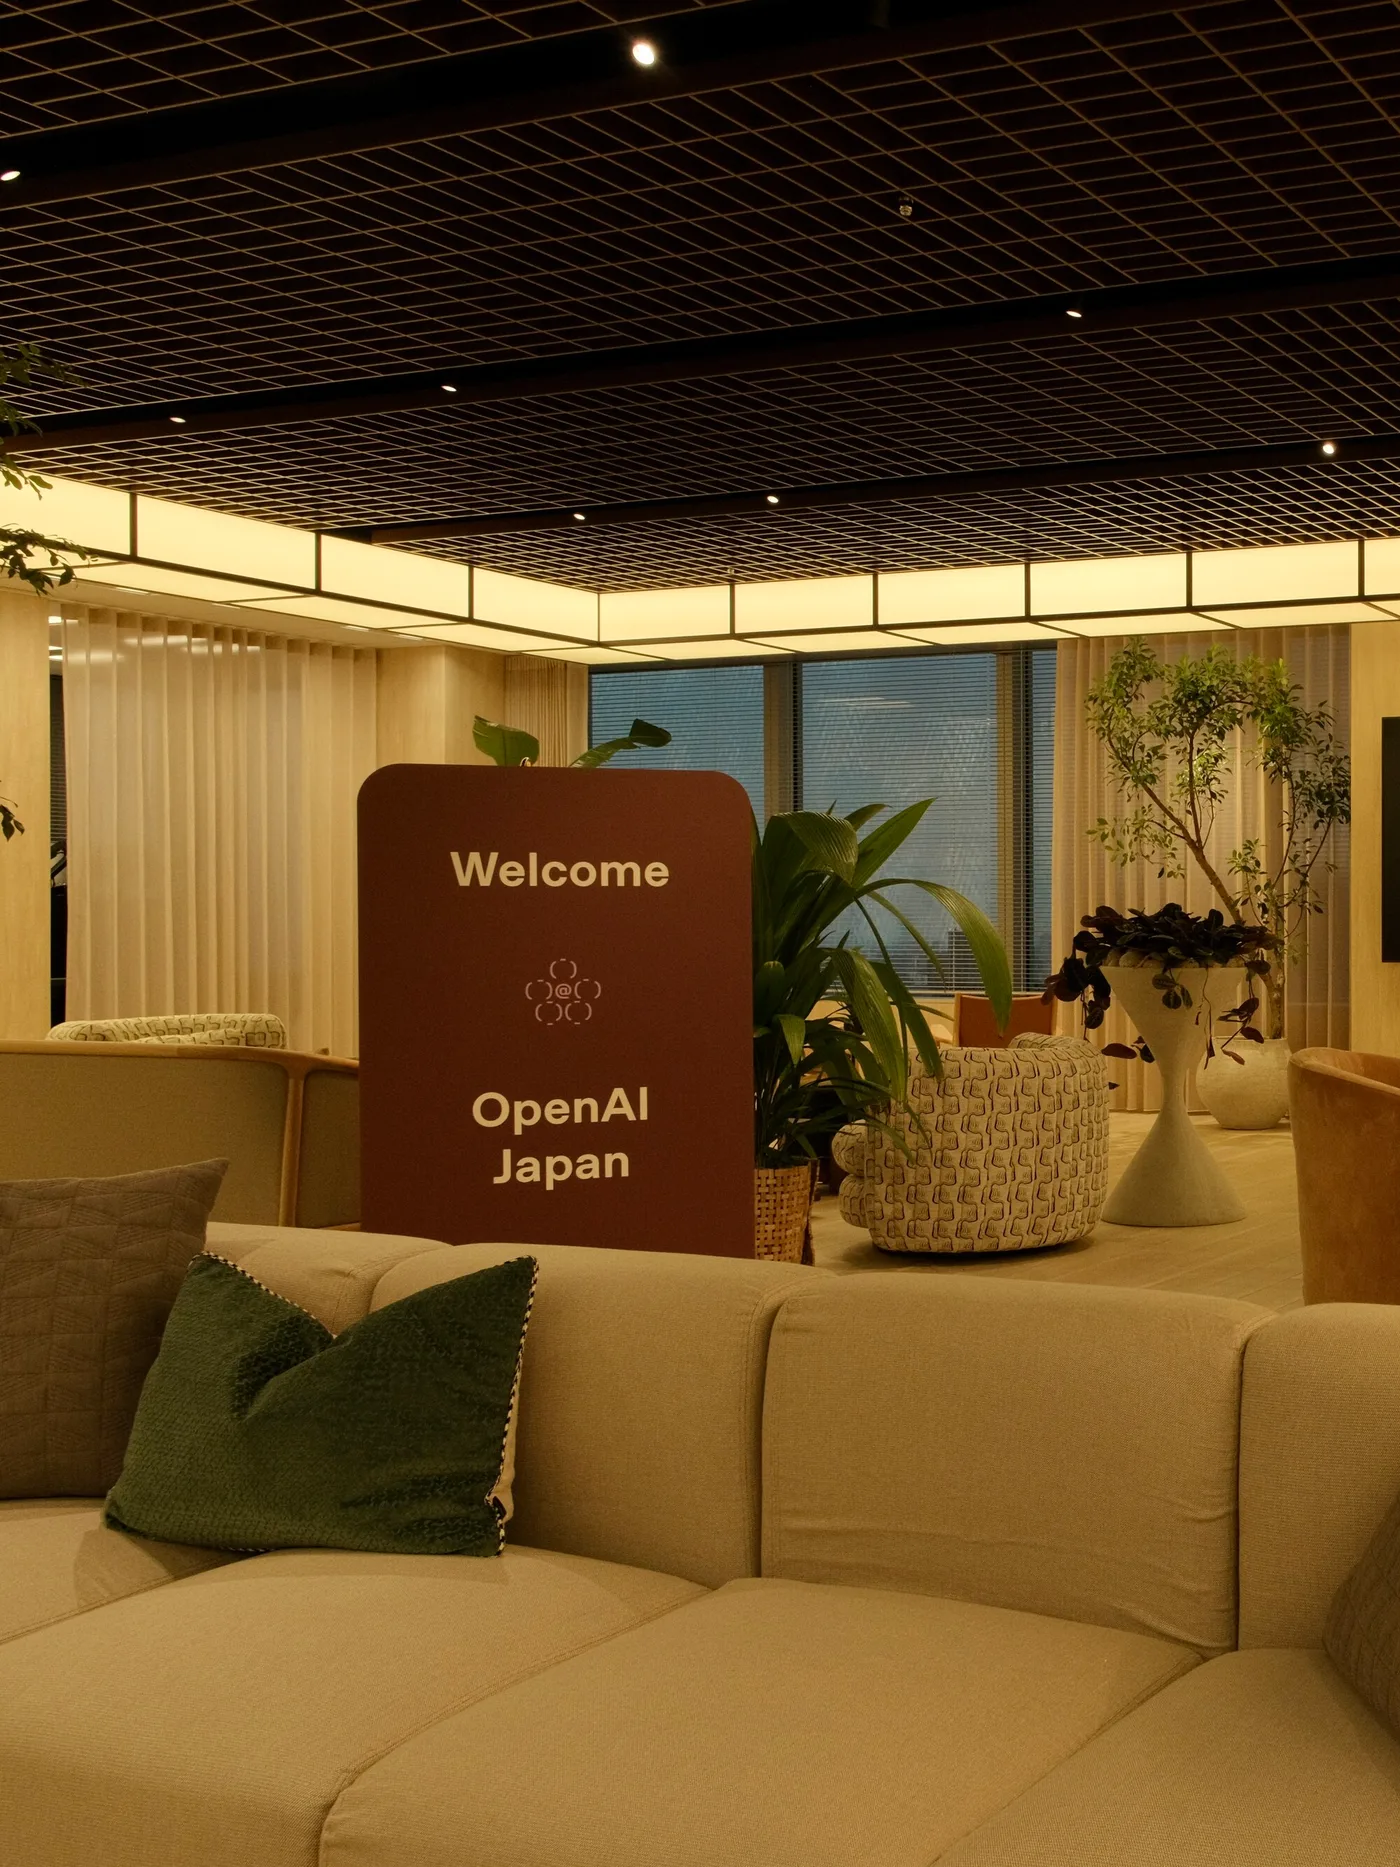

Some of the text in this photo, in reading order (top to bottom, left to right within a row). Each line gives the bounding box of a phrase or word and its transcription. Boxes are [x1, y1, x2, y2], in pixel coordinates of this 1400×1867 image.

[450, 851, 670, 888] Welcome
[472, 1086, 648, 1136] OpenAI
[493, 1148, 629, 1191] Japan
